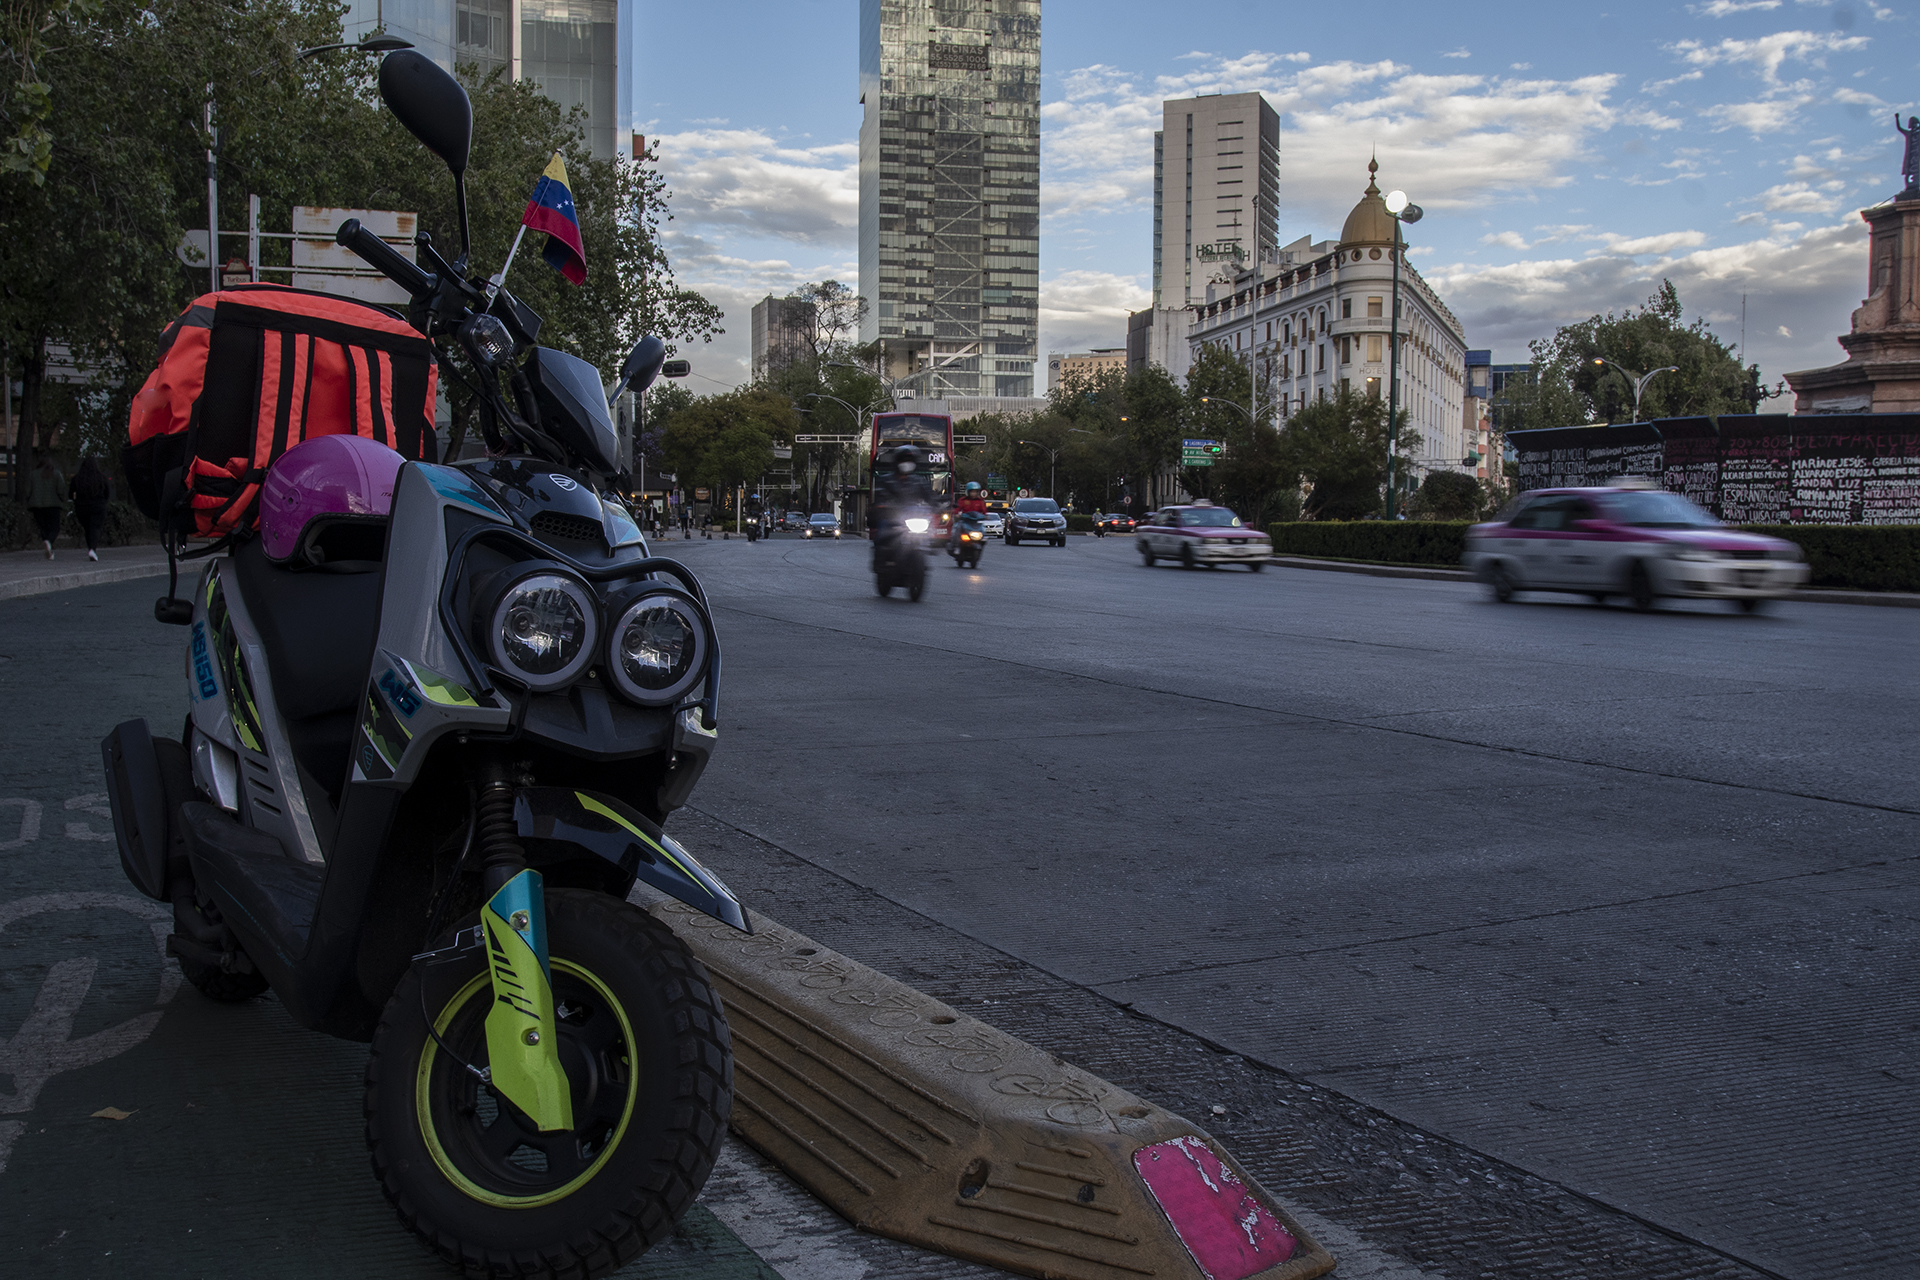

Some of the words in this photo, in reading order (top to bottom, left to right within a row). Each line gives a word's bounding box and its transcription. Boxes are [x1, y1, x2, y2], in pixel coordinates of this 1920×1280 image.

[934, 44, 984, 55] OFICINAS
[966, 55, 988, 64] 1000
[1359, 367, 1387, 375] HOTEL
[1792, 457, 1826, 470] MARÍA
[1827, 458, 1838, 469] DE
[1838, 455, 1867, 469] JESÚS
[1765, 470, 1789, 479] MERINO
[1794, 469, 1835, 479] ALVARADO
[1835, 468, 1877, 479] ESPINOZA
[1792, 478, 1834, 488] SANDRA
[1838, 478, 1861, 489] LUZ
[1724, 489, 1768, 503] ESPERANZA
[1797, 488, 1826, 501] ROMÁN
[1826, 489, 1861, 503] JAIMES
[1789, 498, 1830, 508] TRANQUILINA
[1832, 501, 1851, 510] HDZ
[1863, 500, 1895, 509] ZYANYA
[1749, 510, 1771, 521] LUISA
[1804, 509, 1852, 520] LAGUNAS
[1862, 509, 1888, 518] CECILIA
[379, 668, 422, 719] WS
